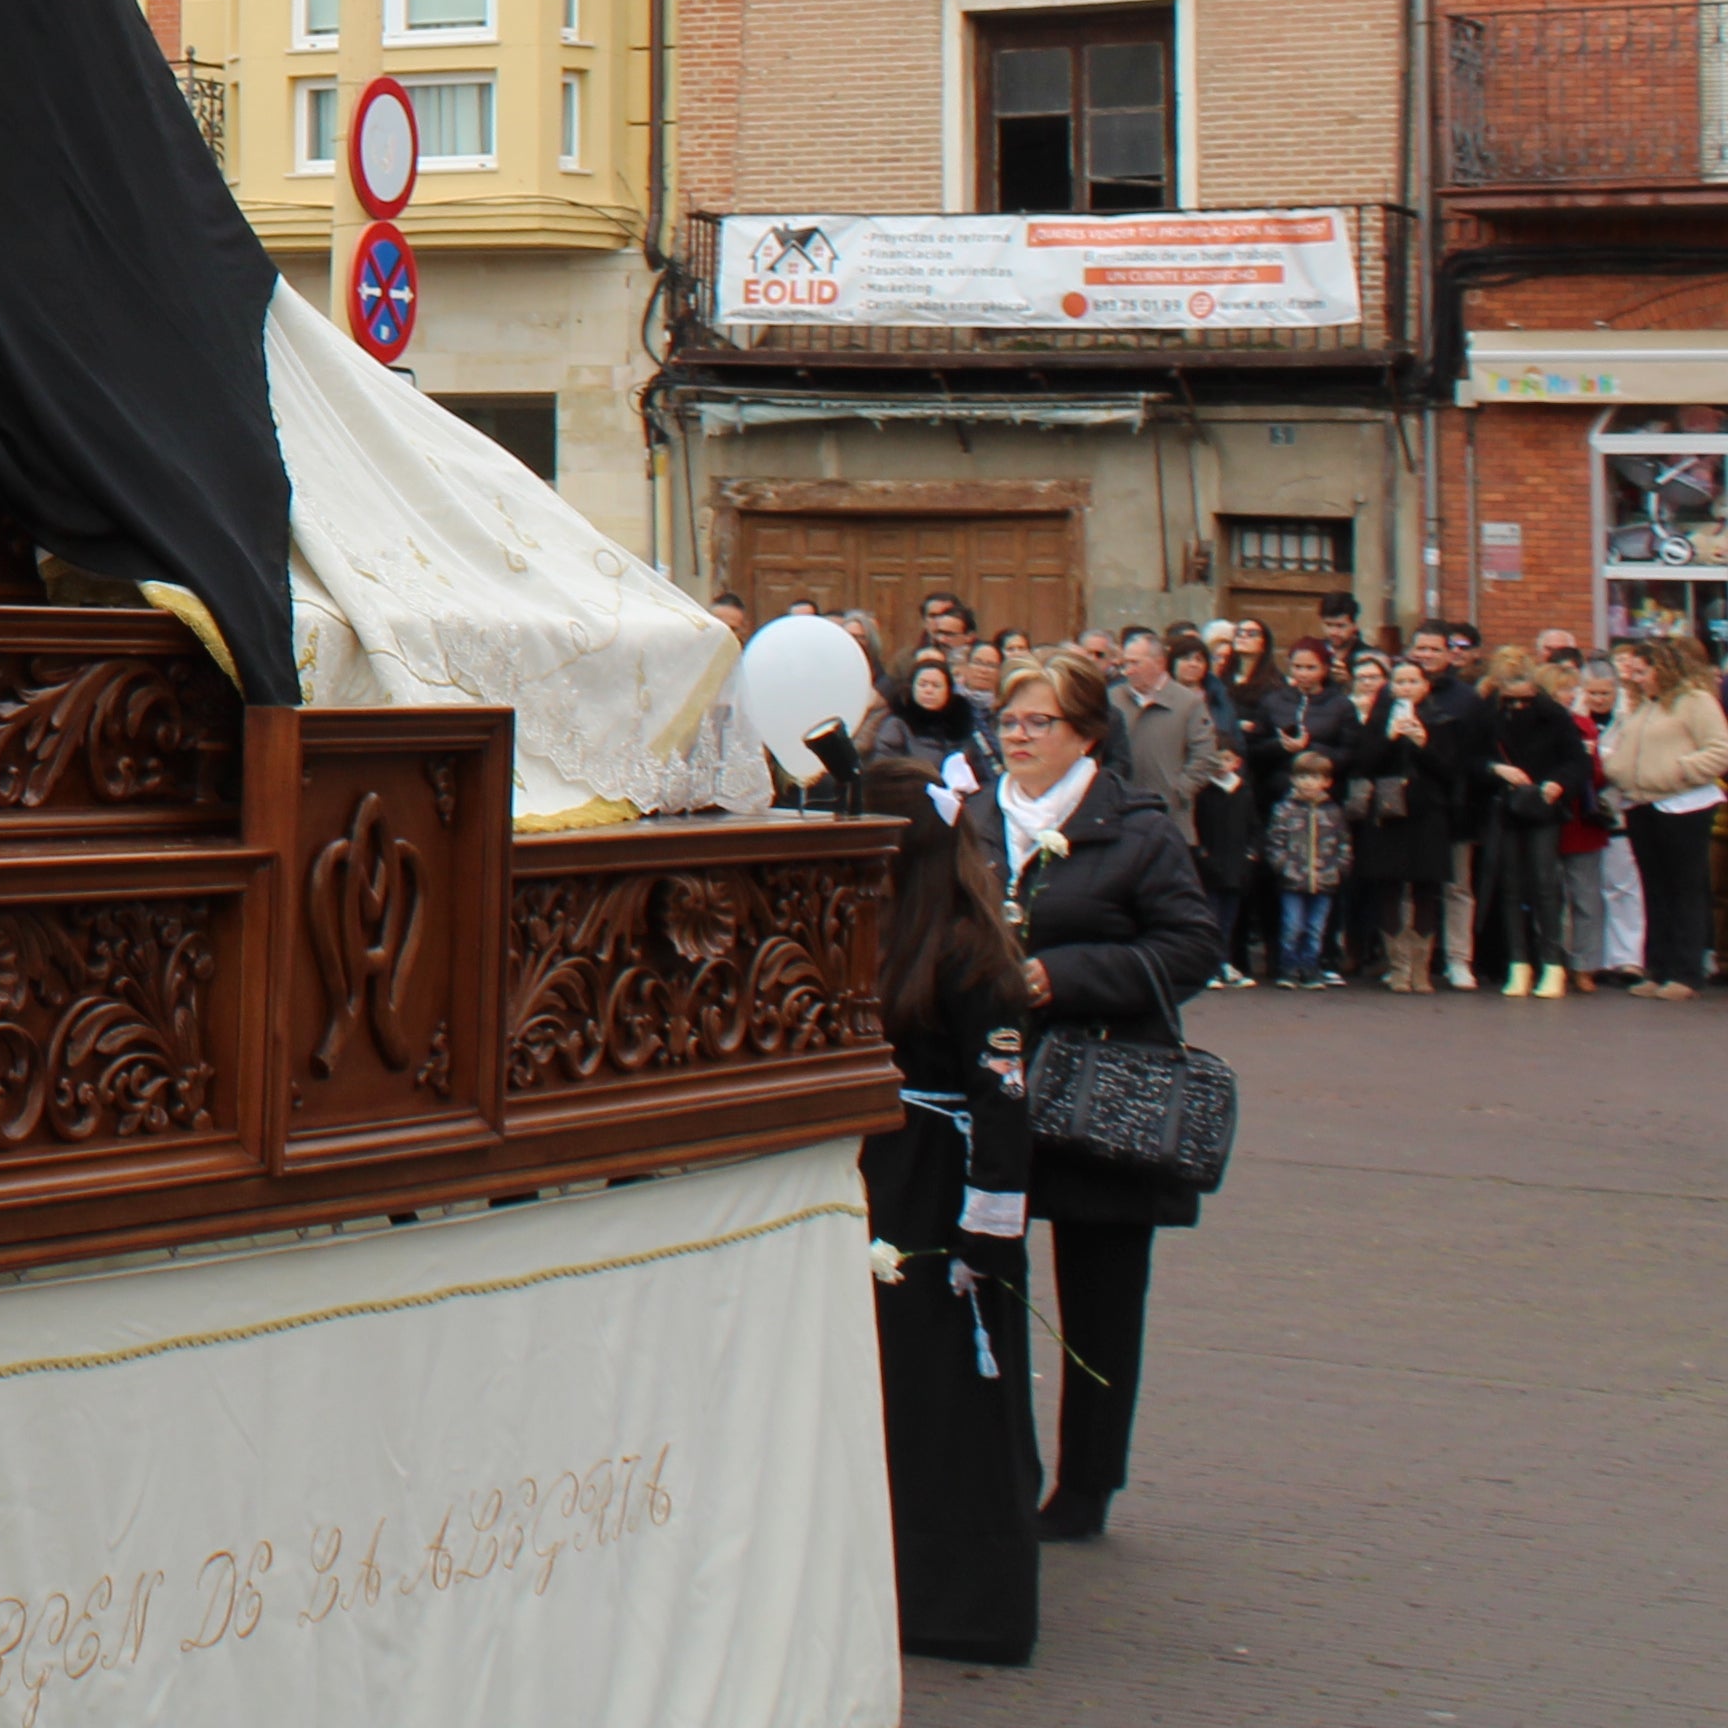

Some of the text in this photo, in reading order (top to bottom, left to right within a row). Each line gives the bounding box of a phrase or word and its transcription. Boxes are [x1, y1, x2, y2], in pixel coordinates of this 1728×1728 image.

[744, 280, 839, 304] EOLID
[180, 1540, 273, 1652] DE
[297, 1516, 387, 1627] LA
[400, 1443, 673, 1595] ALEGRIA
